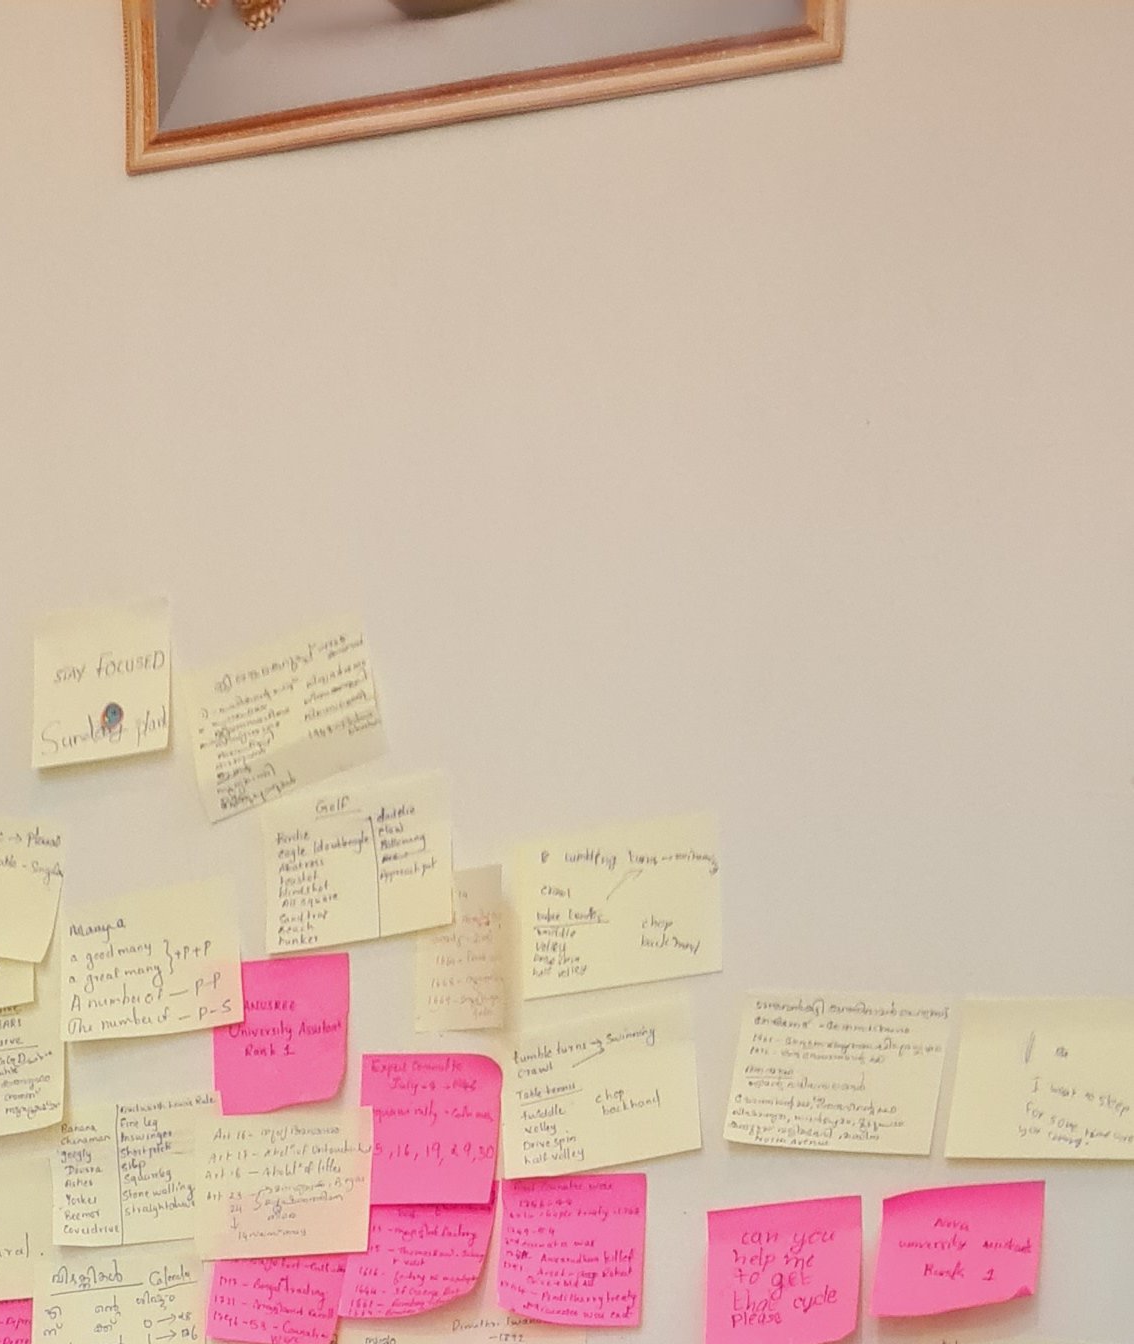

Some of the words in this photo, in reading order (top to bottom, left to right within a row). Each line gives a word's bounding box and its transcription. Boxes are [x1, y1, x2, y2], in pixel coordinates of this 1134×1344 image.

[97, 650, 165, 678] FOCUSED
[316, 795, 349, 813] Golf
[86, 943, 114, 971] good
[117, 943, 152, 957] many
[124, 964, 164, 988] many
[70, 994, 81, 1012] A
[87, 982, 141, 1008] number
[101, 1006, 152, 1031] number
[229, 1020, 293, 1041] University
[245, 1043, 275, 1057] Rank
[741, 1232, 779, 1245] can
[789, 1231, 835, 1255] you
[732, 1246, 776, 1272] help
[783, 1254, 815, 1270] me
[733, 1268, 760, 1285] to
[770, 1271, 811, 1301] get
[793, 1284, 838, 1313] cycle
[731, 1311, 783, 1329] please
